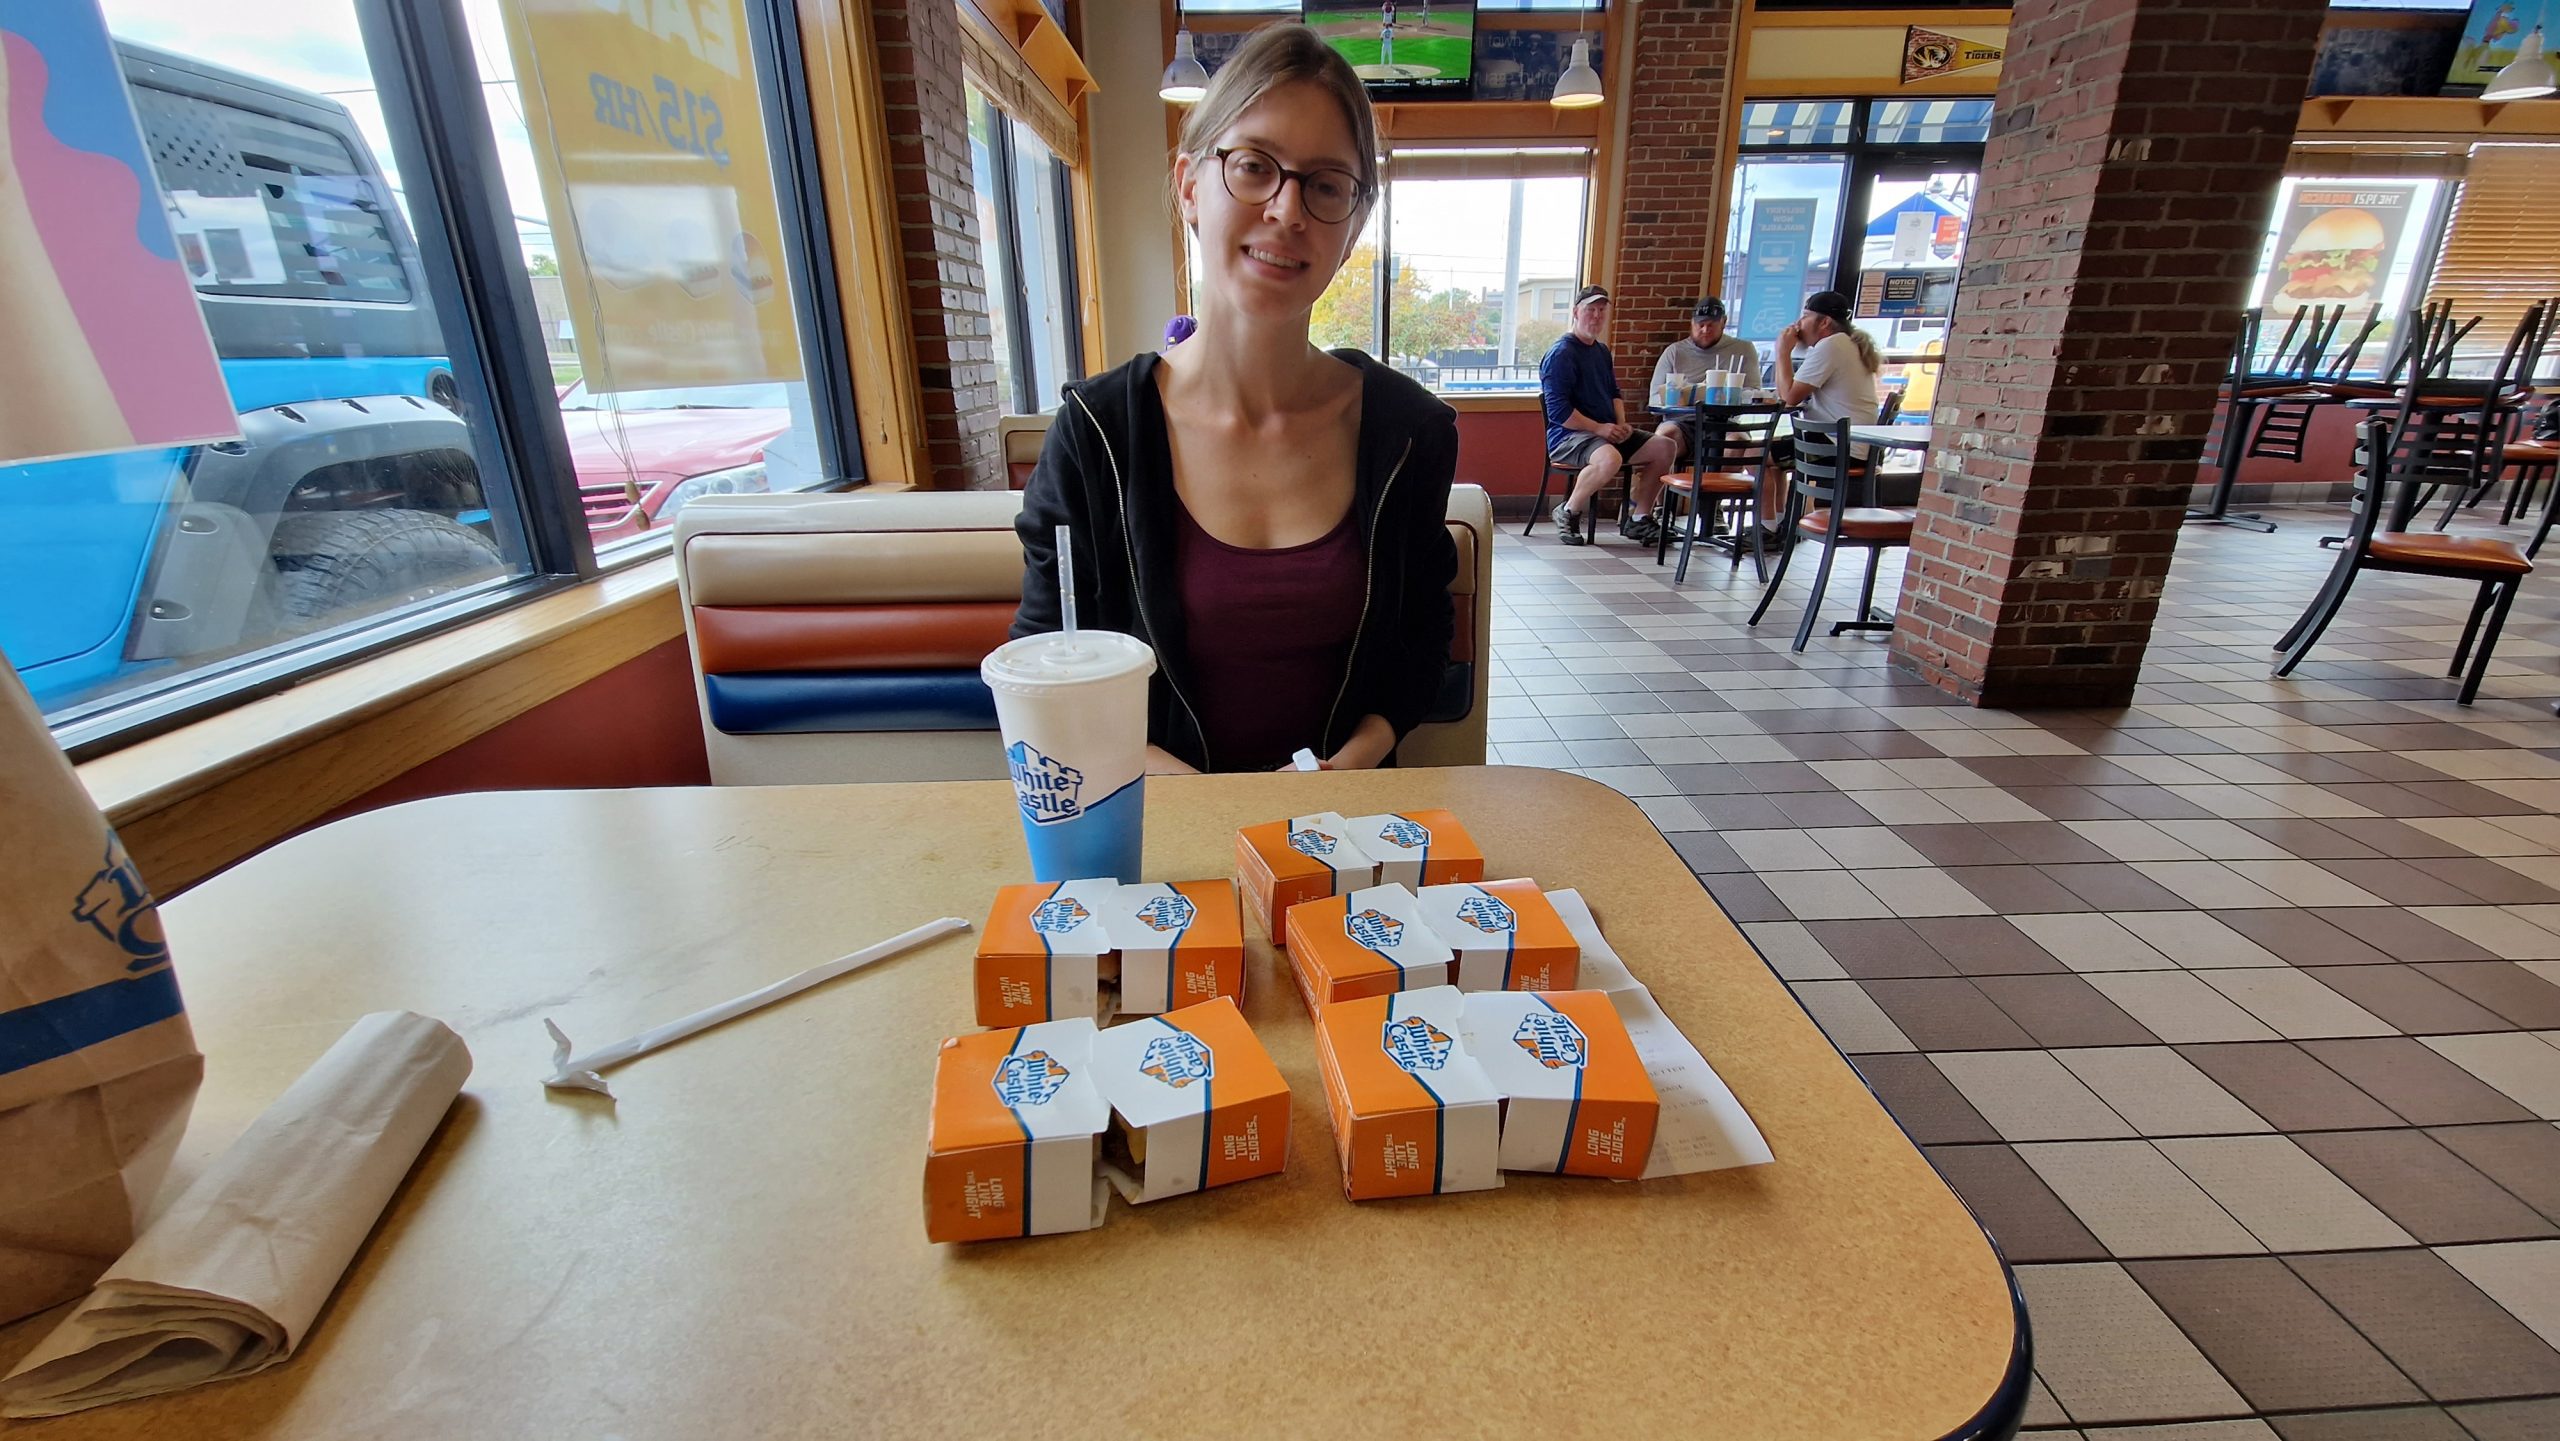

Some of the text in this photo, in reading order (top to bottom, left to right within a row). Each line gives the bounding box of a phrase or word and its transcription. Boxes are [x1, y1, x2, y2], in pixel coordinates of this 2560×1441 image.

[1964, 51, 2001, 60] TIGERS
[1889, 278, 1917, 286] NOTICE
[1017, 788, 1077, 813] astle
[1040, 901, 1059, 932] Castle
[1056, 902, 1075, 930] White
[1154, 900, 1171, 927] White
[1170, 896, 1186, 927] Castle
[1471, 900, 1494, 928] White
[1486, 897, 1512, 930] Castle
[1350, 915, 1378, 948] Castle
[1367, 914, 1392, 944] White
[1010, 983, 1023, 1003] LIVE
[1020, 981, 1032, 1005] LONG
[1185, 971, 1197, 994] LONG
[1196, 973, 1207, 993] LIVE
[1520, 974, 1530, 991] ONG
[1530, 977, 1540, 991] IVE
[1388, 1024, 1418, 1069] Castle
[1406, 1024, 1435, 1065] White
[1534, 1018, 1560, 1060] White
[1550, 1016, 1582, 1065] Castle
[1158, 1041, 1188, 1081] White
[1175, 1036, 1208, 1078] Castle
[1006, 1058, 1026, 1103] Castle
[1023, 1058, 1046, 1099] White
[1224, 1135, 1236, 1160] LONG
[1235, 1135, 1248, 1156] LIVE
[1395, 1144, 1408, 1168] LIVE
[1406, 1141, 1420, 1169] LONG
[1587, 1129, 1599, 1156] LONG
[1600, 1132, 1611, 1155] LIVE
[1384, 1147, 1397, 1178] NIGHT
[964, 1185, 981, 1218] NIGHT
[977, 1182, 992, 1207] LIVE
[990, 1178, 1005, 1208] LONG
